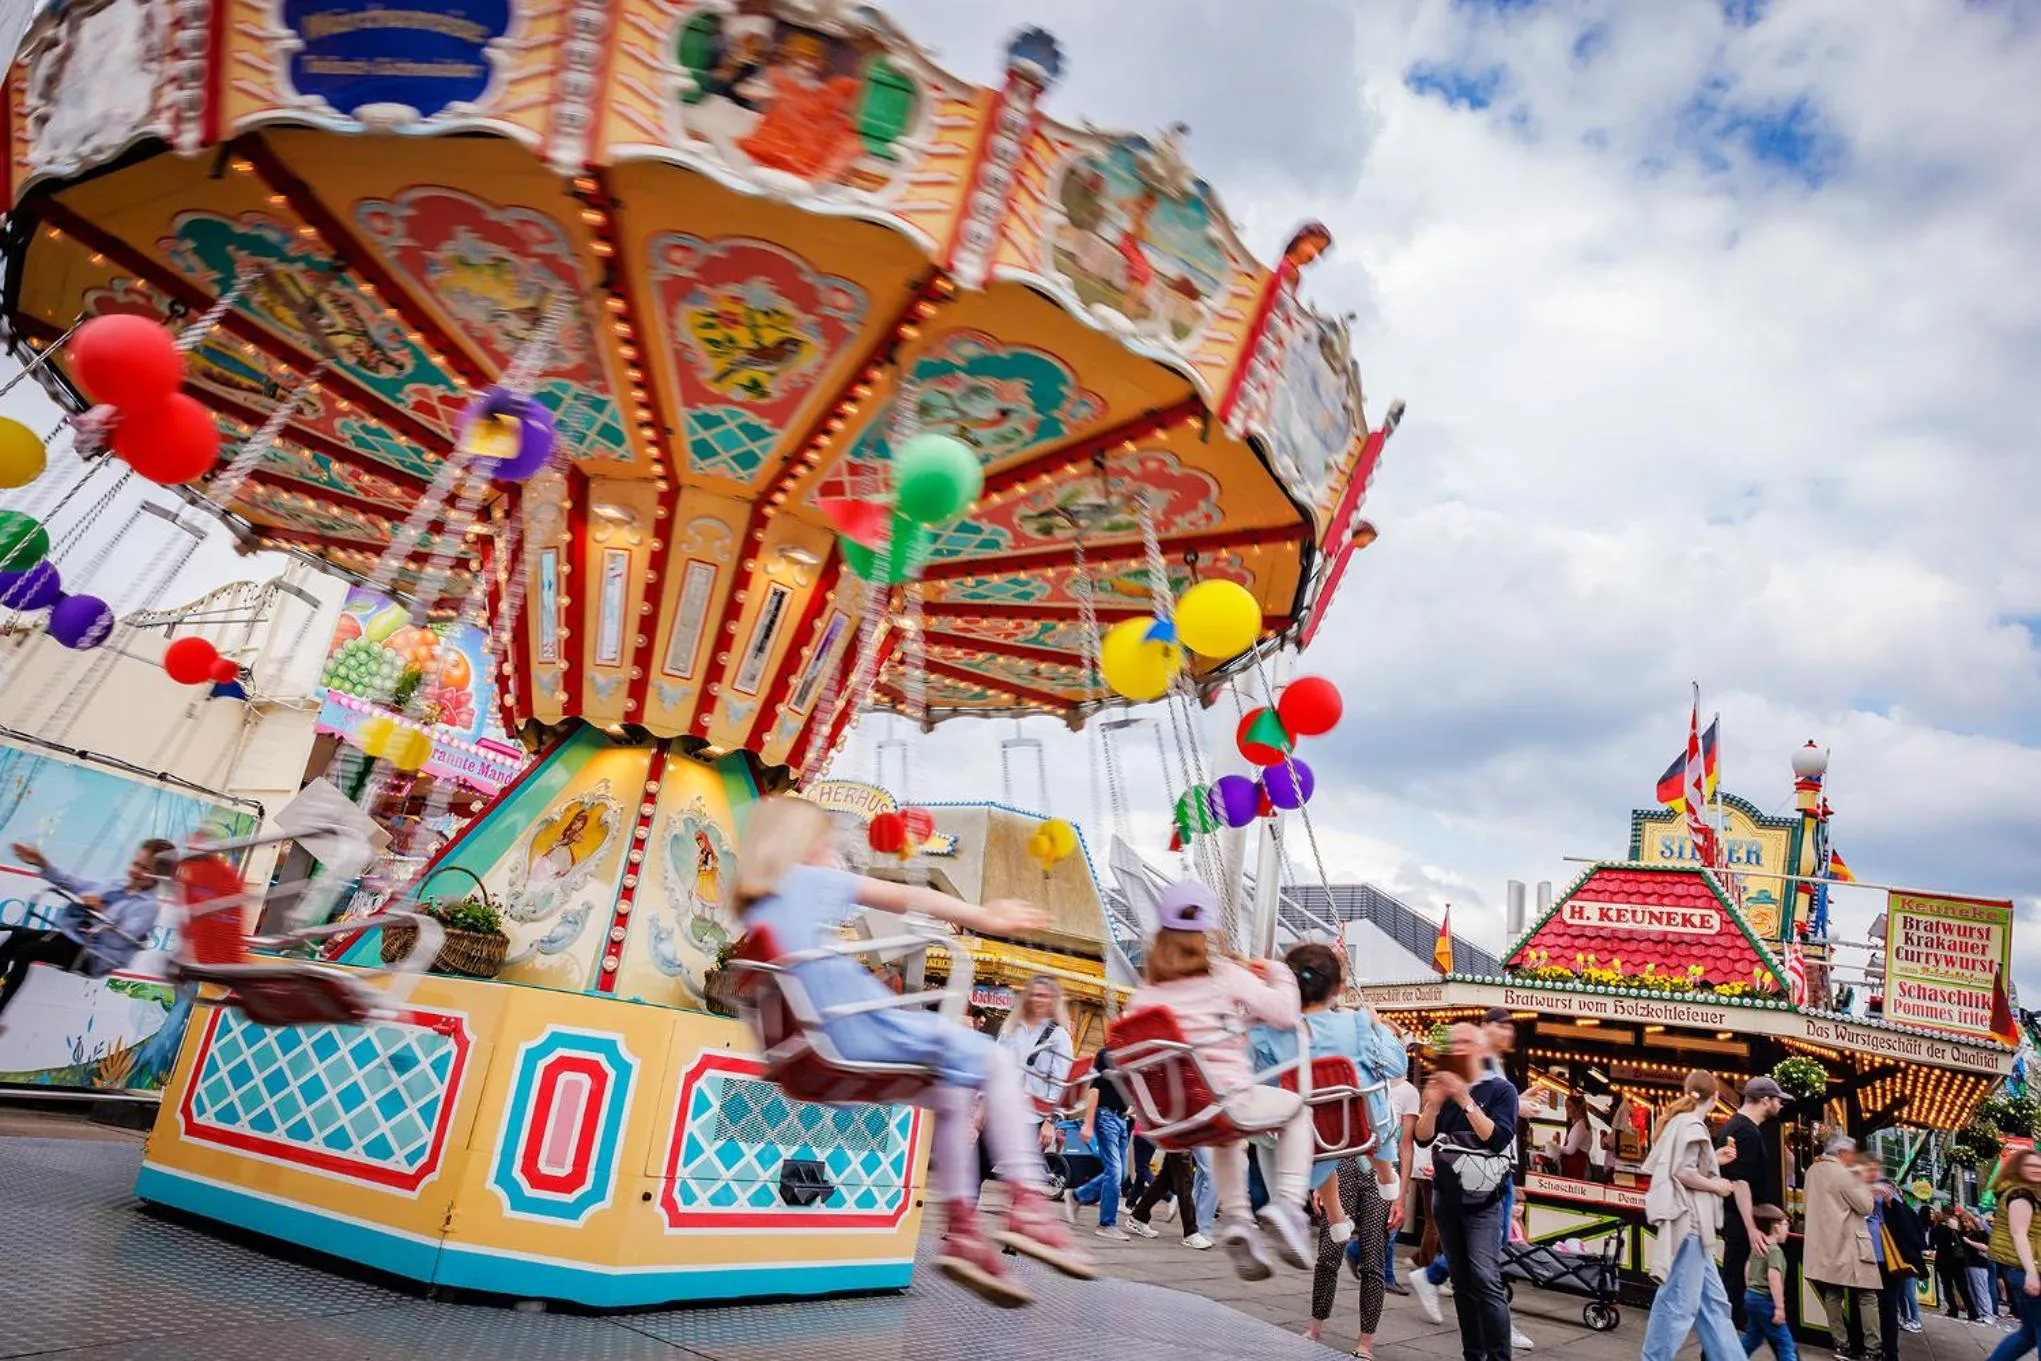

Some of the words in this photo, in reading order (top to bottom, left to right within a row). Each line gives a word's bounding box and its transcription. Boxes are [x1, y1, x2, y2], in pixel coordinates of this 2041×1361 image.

[1660, 834, 1762, 866] SILER
[1569, 905, 1591, 921] H.
[1598, 906, 1714, 929] KEUNEKE
[1900, 897, 1998, 920] Keuneke
[1902, 915, 1992, 941] Bratwurst
[1904, 931, 1989, 956] Krakauer
[1895, 945, 1995, 974] Currywurst
[1503, 988, 1573, 1010] Bratwurst
[1579, 999, 1608, 1014] vom
[1613, 998, 1726, 1025] Holzkohlefeuer
[1898, 981, 1993, 1010] Schaschlik
[1893, 998, 1954, 1022] Pommes
[1805, 1019, 1830, 1040] Das
[1834, 1025, 1923, 1056] Wurstgeschäft
[1926, 1043, 1947, 1061] der
[1951, 1047, 1999, 1070] Qualität
[1537, 1178, 1587, 1196] Schaschlik
